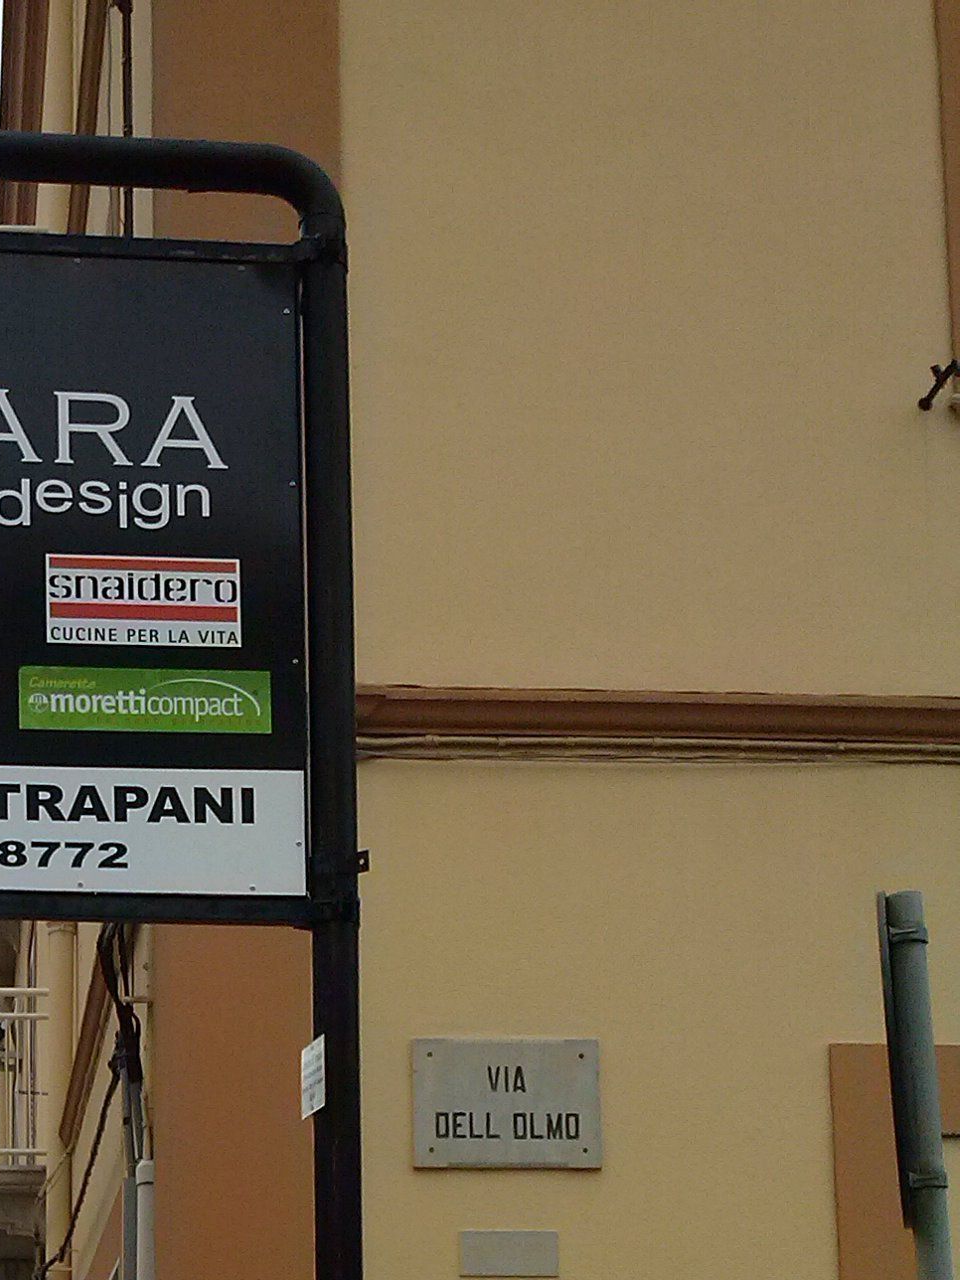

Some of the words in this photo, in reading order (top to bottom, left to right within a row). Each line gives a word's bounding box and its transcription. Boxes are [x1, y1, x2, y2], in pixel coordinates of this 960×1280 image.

[48, 572, 238, 603] snaidero
[50, 626, 118, 642] CUCINE
[127, 628, 159, 643] PER
[169, 630, 190, 643] LA
[198, 630, 239, 645] VITA
[486, 1065, 527, 1093] VIA
[435, 1111, 501, 1139] DELL
[512, 1112, 580, 1140] OLMO
